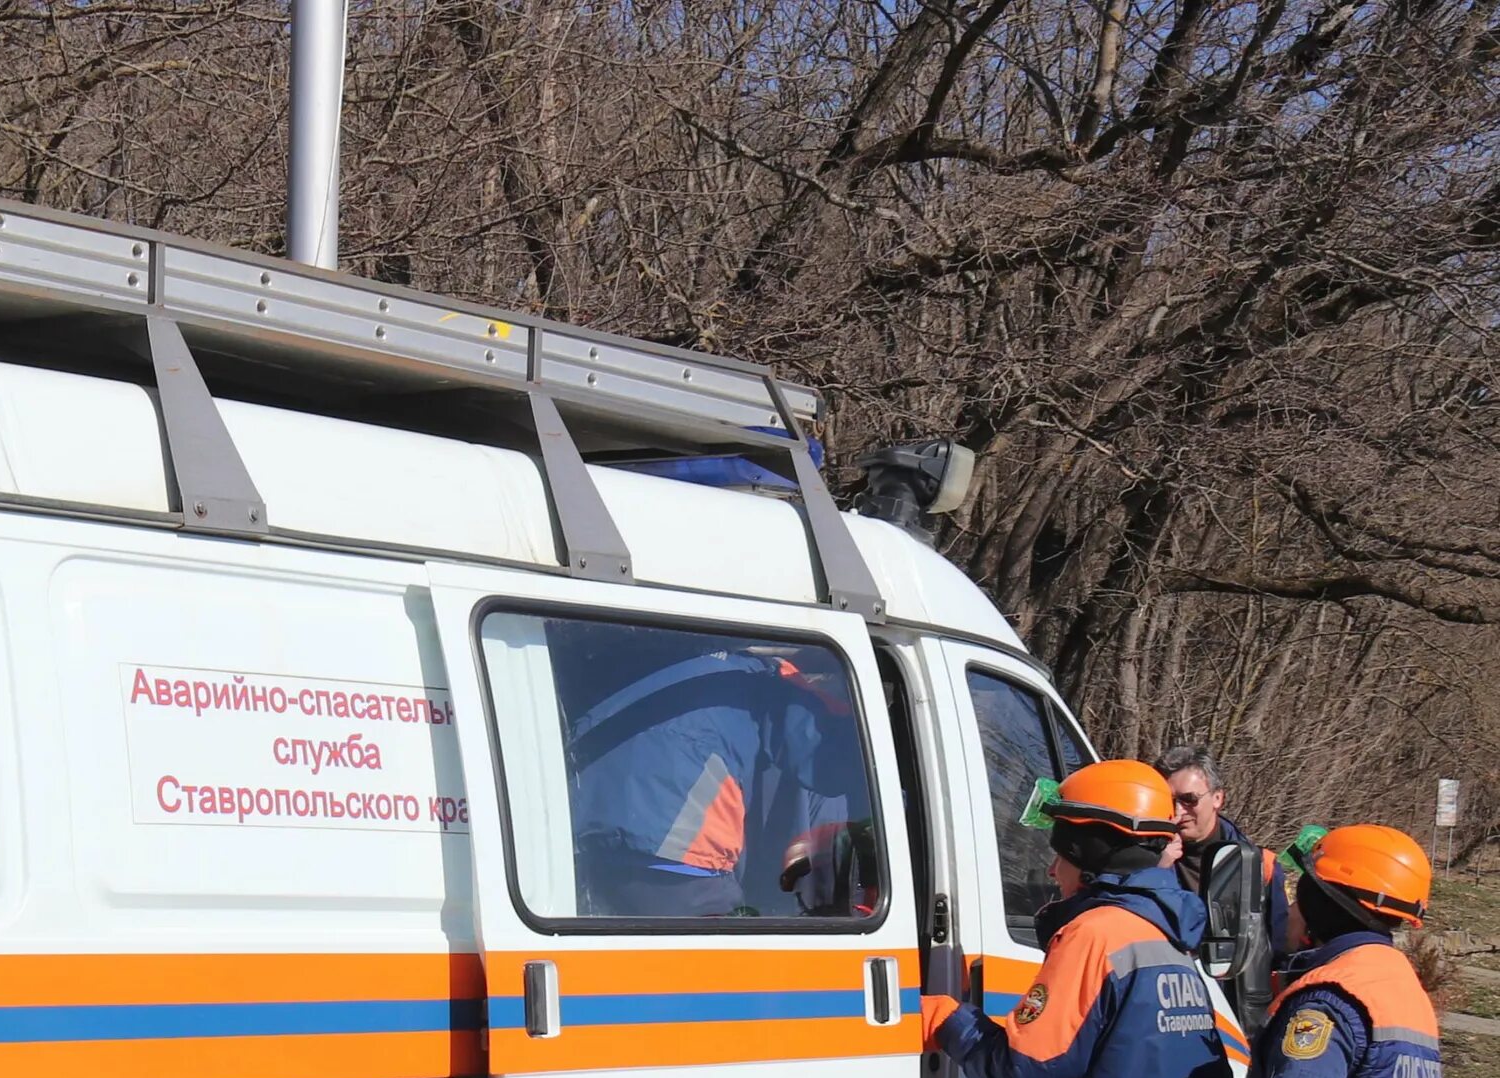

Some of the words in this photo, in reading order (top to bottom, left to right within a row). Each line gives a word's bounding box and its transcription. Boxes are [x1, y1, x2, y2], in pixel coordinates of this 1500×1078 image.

[273, 733, 382, 775] служба
[156, 775, 420, 823] Ставропольского
[428, 797, 469, 831] кра
[1157, 973, 1205, 1009] СПАС
